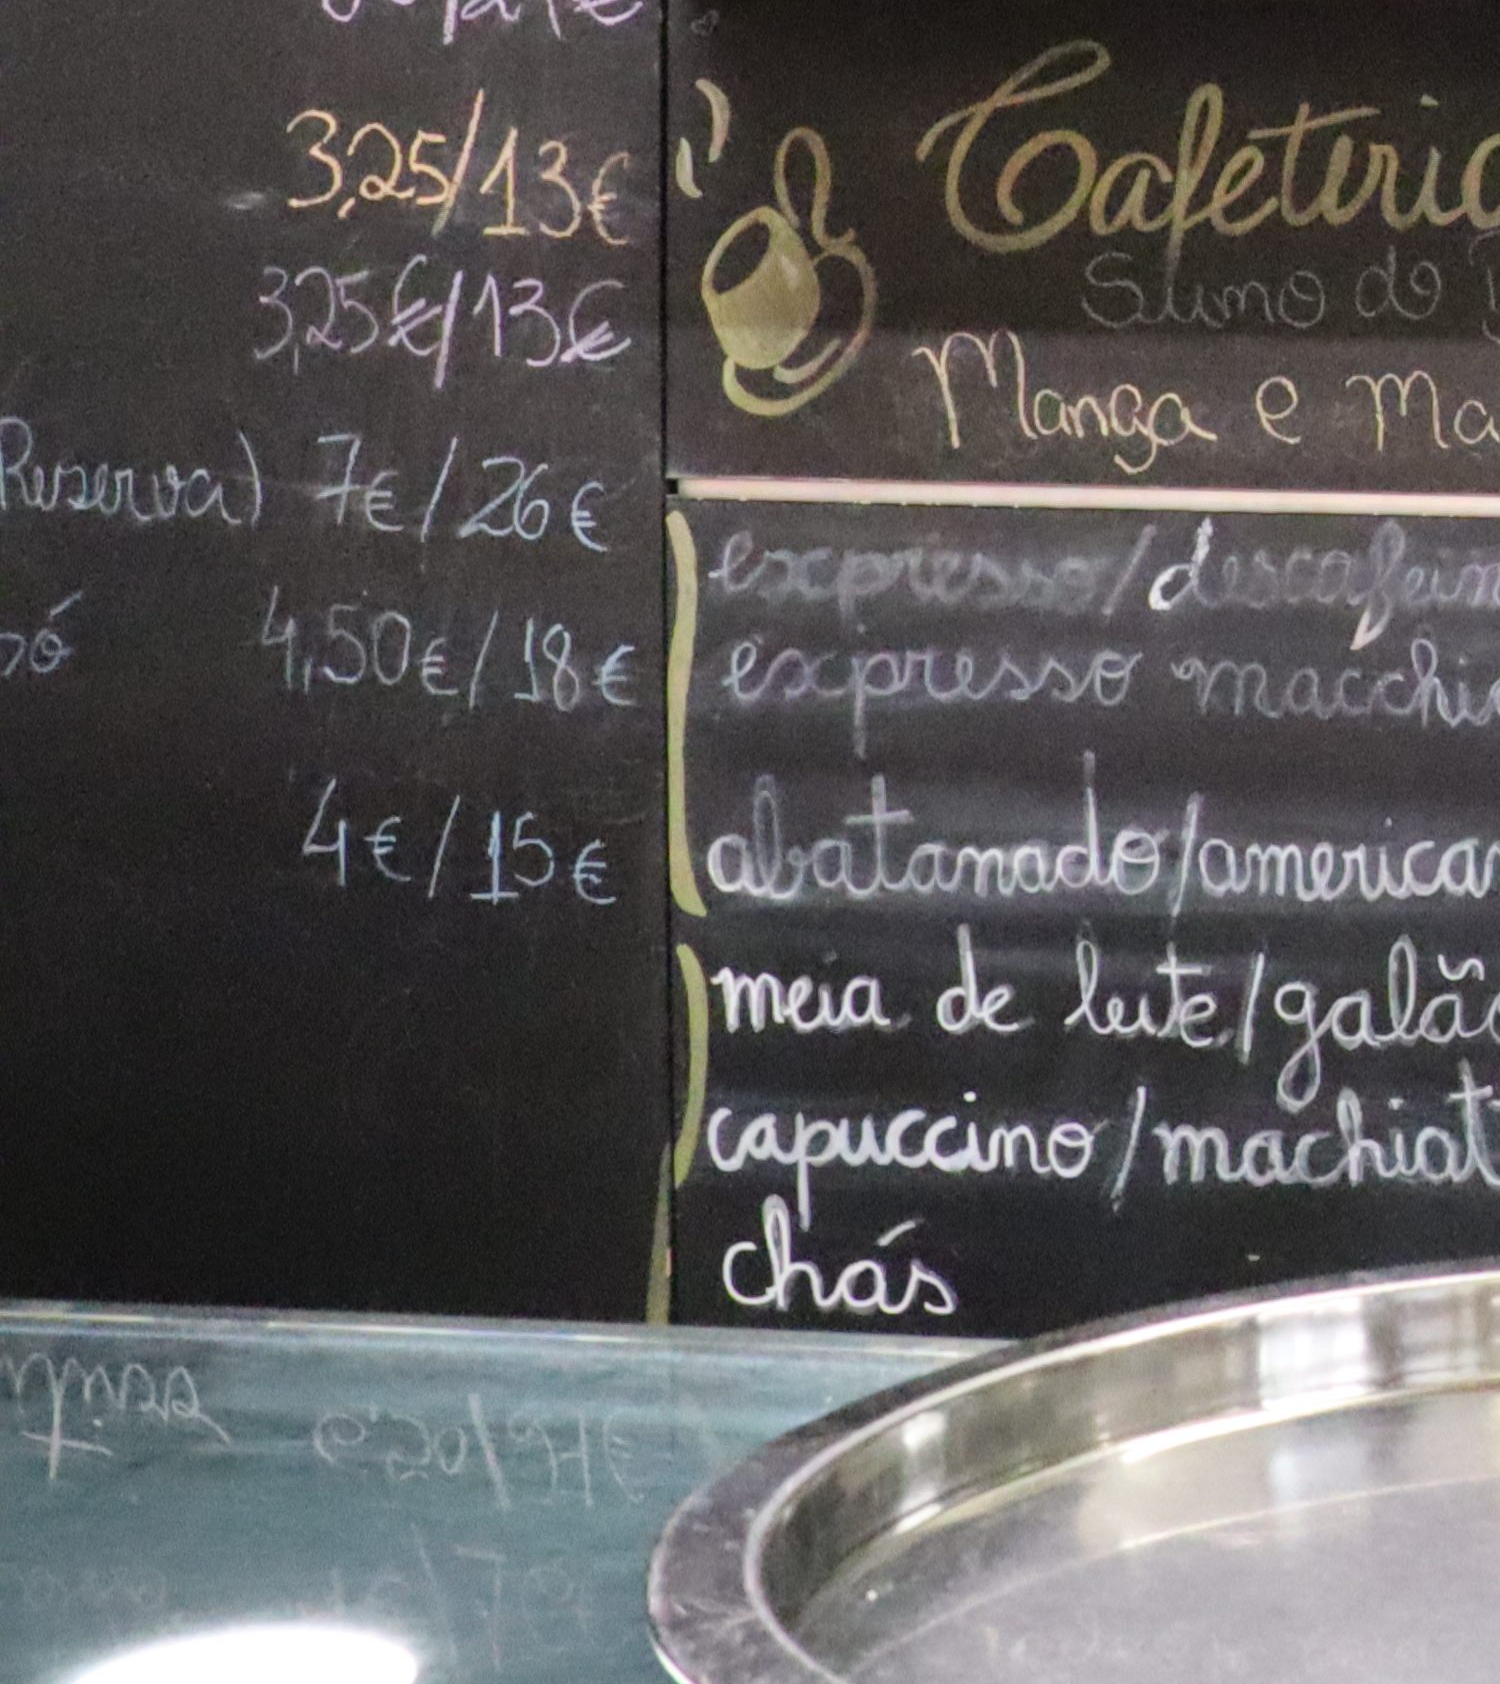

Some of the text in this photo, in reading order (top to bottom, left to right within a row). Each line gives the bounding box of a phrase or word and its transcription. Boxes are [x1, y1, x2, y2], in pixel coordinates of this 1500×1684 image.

[285, 86, 632, 246] 3,25/13€
[253, 253, 632, 390] 3,25€/13€
[1355, 244, 1443, 320] do
[912, 329, 1217, 474] Manga
[1256, 376, 1303, 444] e
[712, 952, 893, 1032] meia
[936, 922, 1030, 1033] de
[722, 1196, 958, 1316] chás
